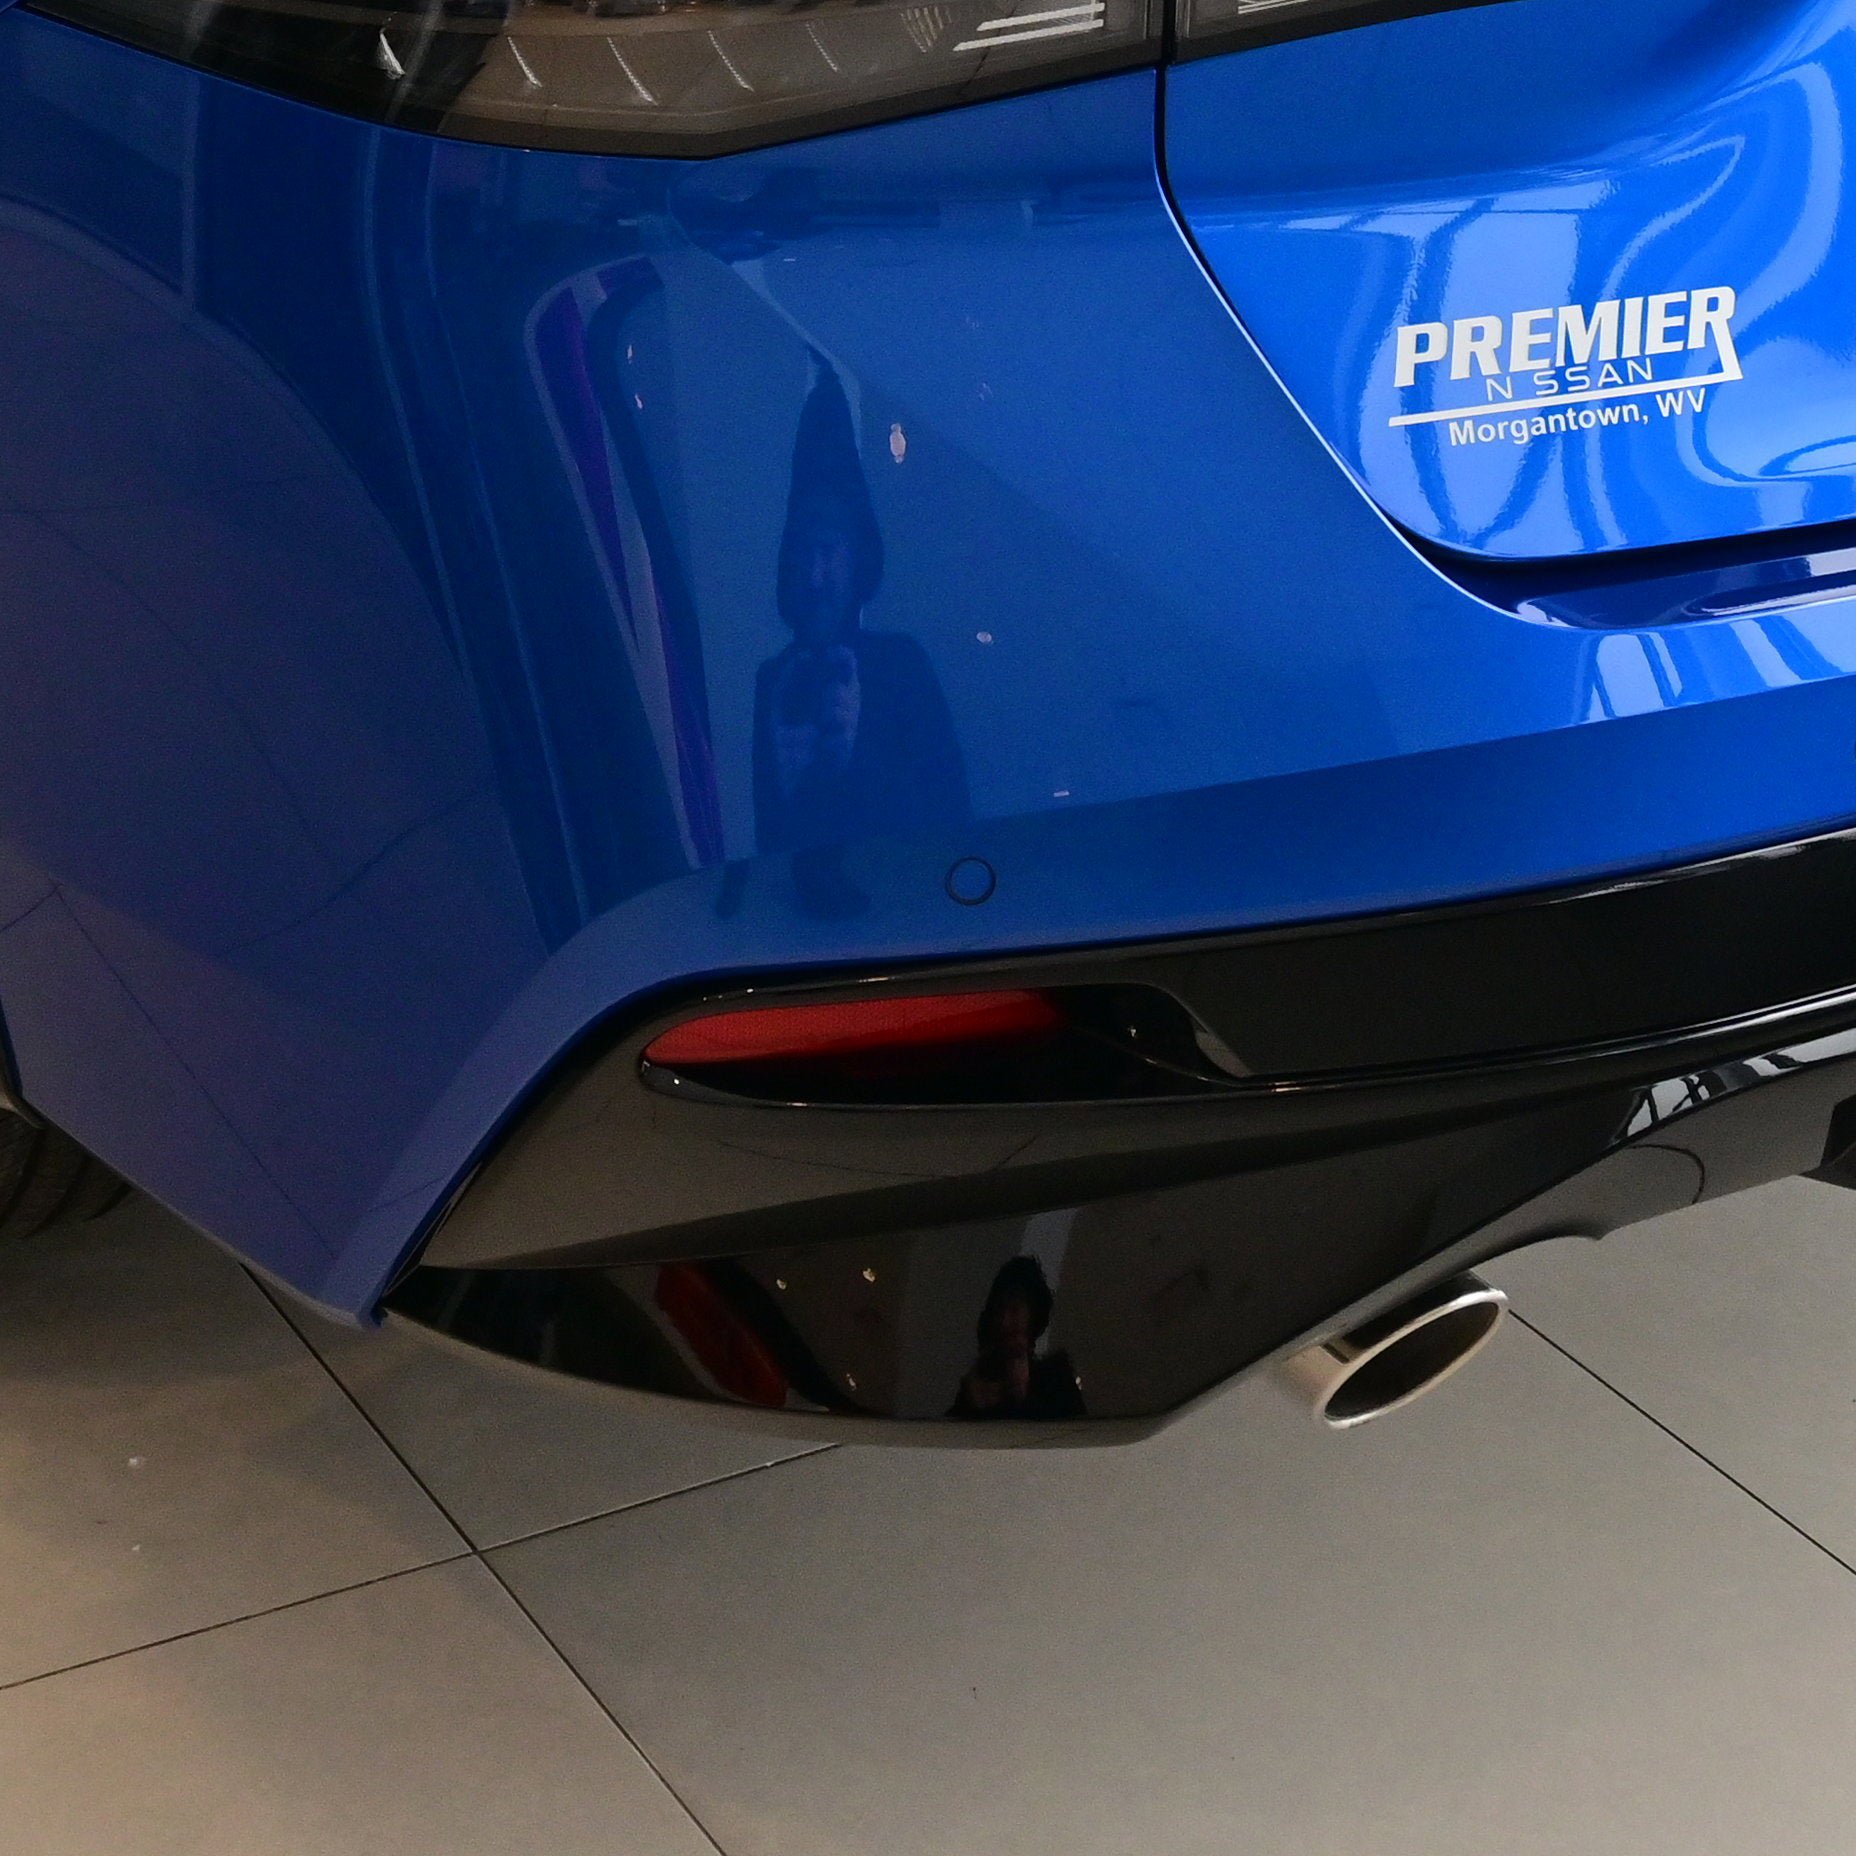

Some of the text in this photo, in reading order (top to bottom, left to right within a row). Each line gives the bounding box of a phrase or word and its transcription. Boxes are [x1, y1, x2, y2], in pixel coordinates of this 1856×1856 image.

[1393, 285, 1744, 389] PREMIER
[1448, 387, 1706, 447] Morgantown, WV
